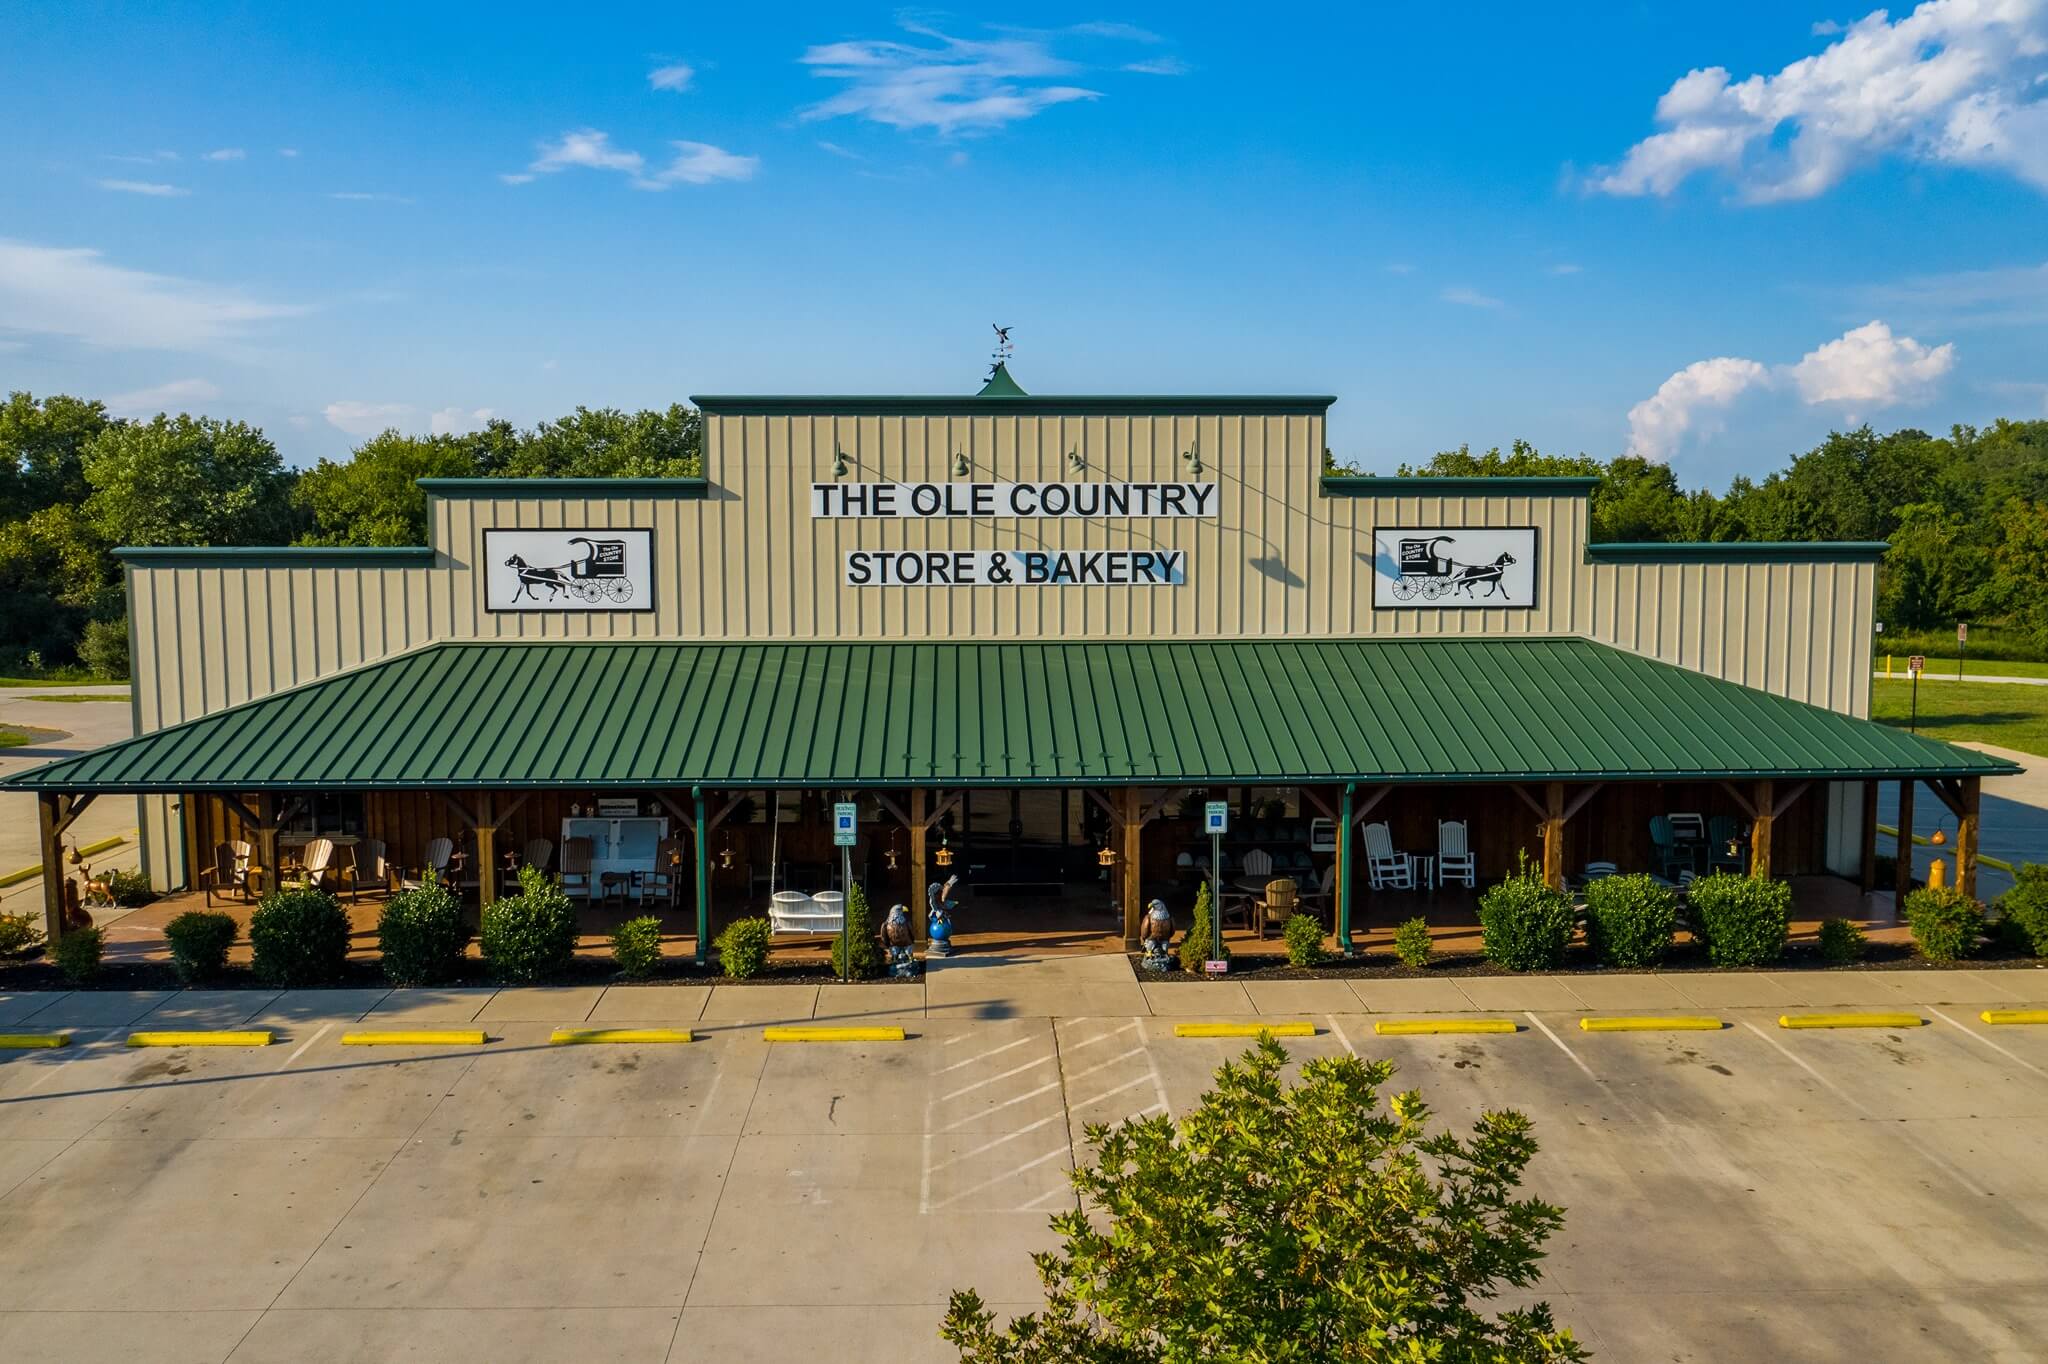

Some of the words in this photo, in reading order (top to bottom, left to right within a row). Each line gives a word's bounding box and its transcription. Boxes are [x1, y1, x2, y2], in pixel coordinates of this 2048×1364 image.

[814, 484, 896, 516] THE
[911, 484, 995, 516] OLE
[1011, 484, 1214, 516] COUNTRY
[848, 552, 975, 584] STORE
[987, 552, 1012, 584] &
[1025, 552, 1180, 583] BAKERY
